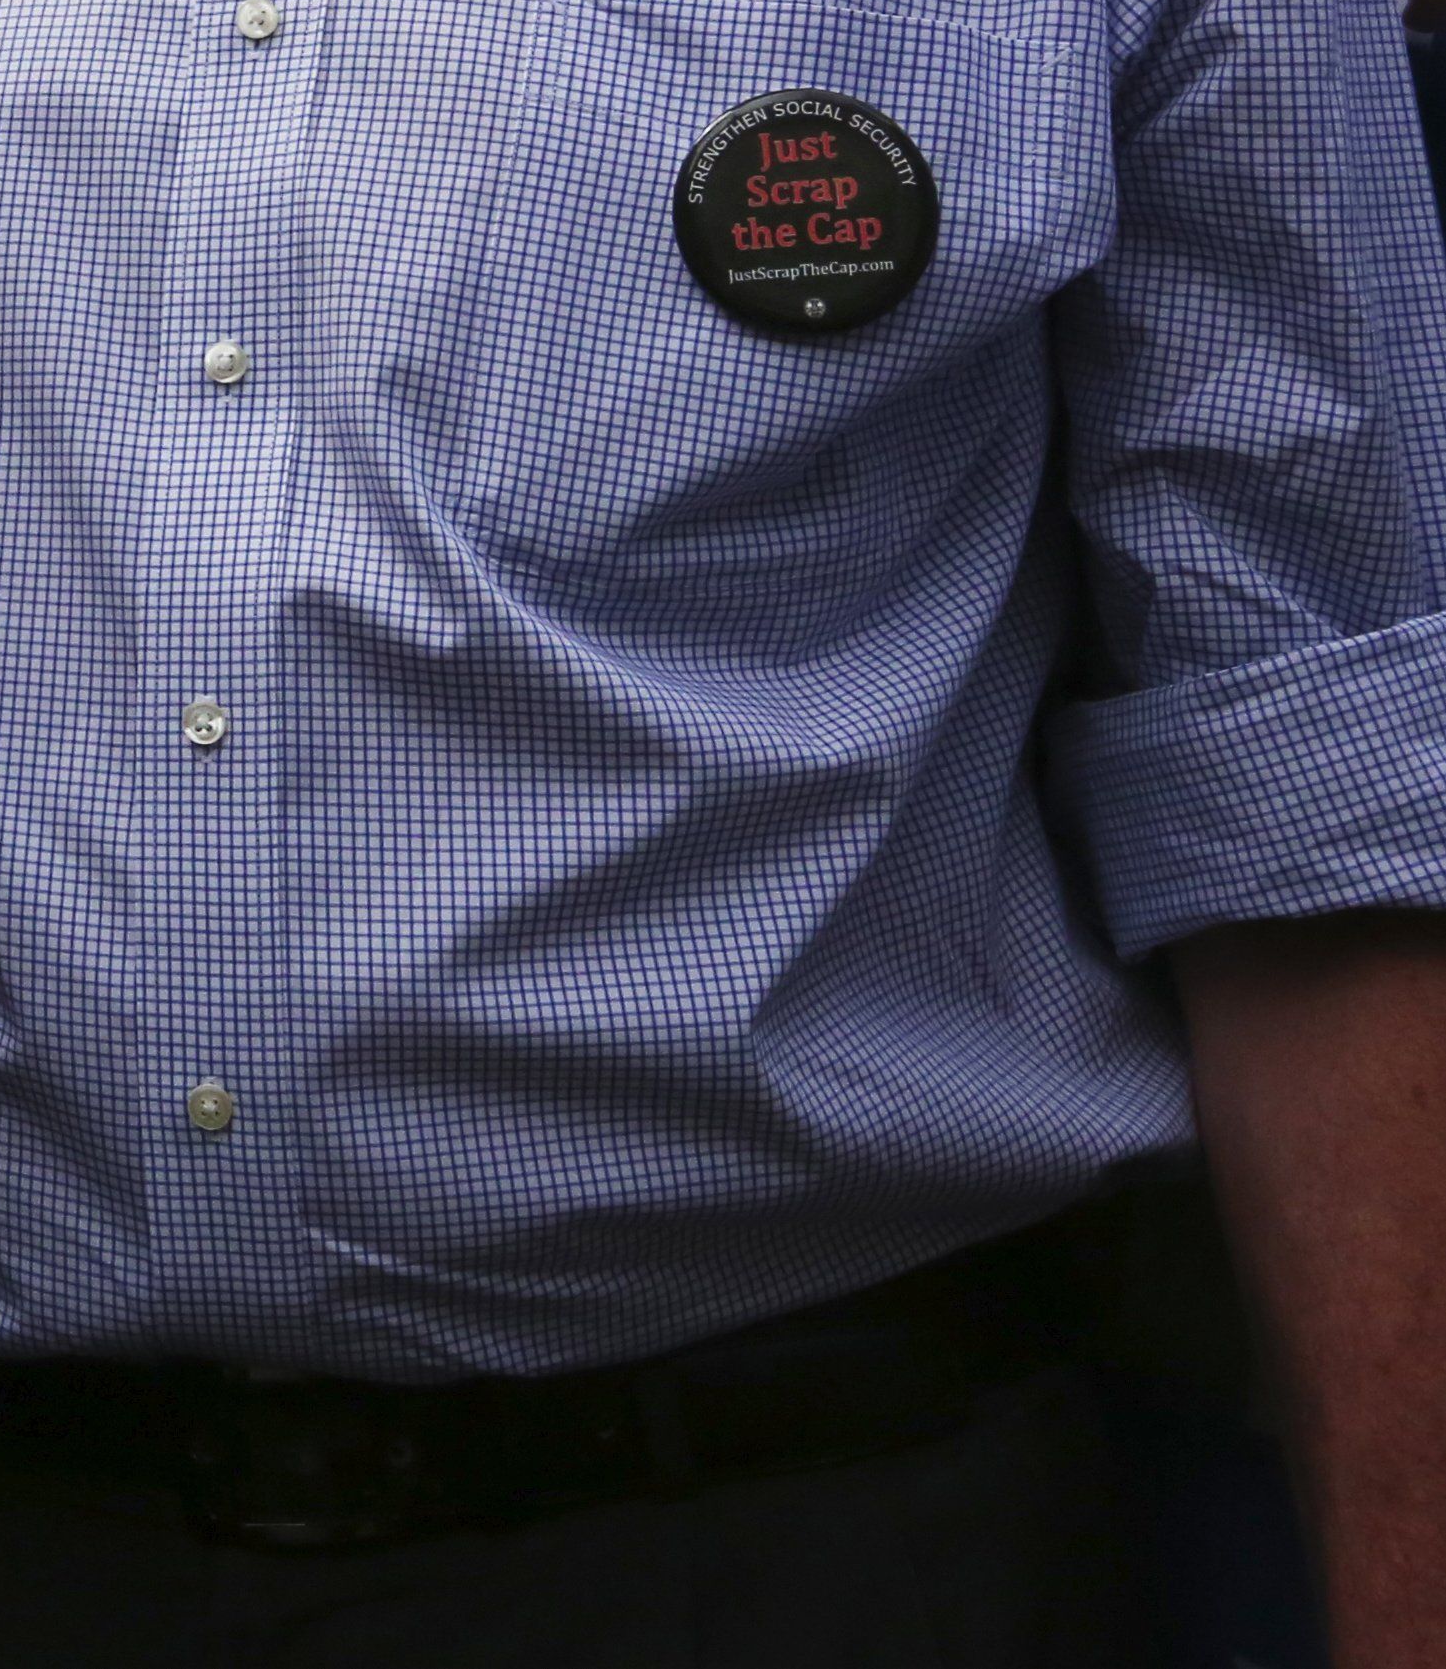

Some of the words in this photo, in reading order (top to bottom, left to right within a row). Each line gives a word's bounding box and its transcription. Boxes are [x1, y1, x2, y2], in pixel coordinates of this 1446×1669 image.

[689, 109, 768, 204] STRENGTHEN
[773, 101, 843, 122] SOCIAL
[849, 114, 917, 187] SECURITY
[758, 131, 837, 172] Just
[746, 175, 858, 209] Scrap
[731, 217, 797, 251] the
[807, 212, 883, 250] Cap
[728, 260, 894, 284] JustScrapTheCap.com
